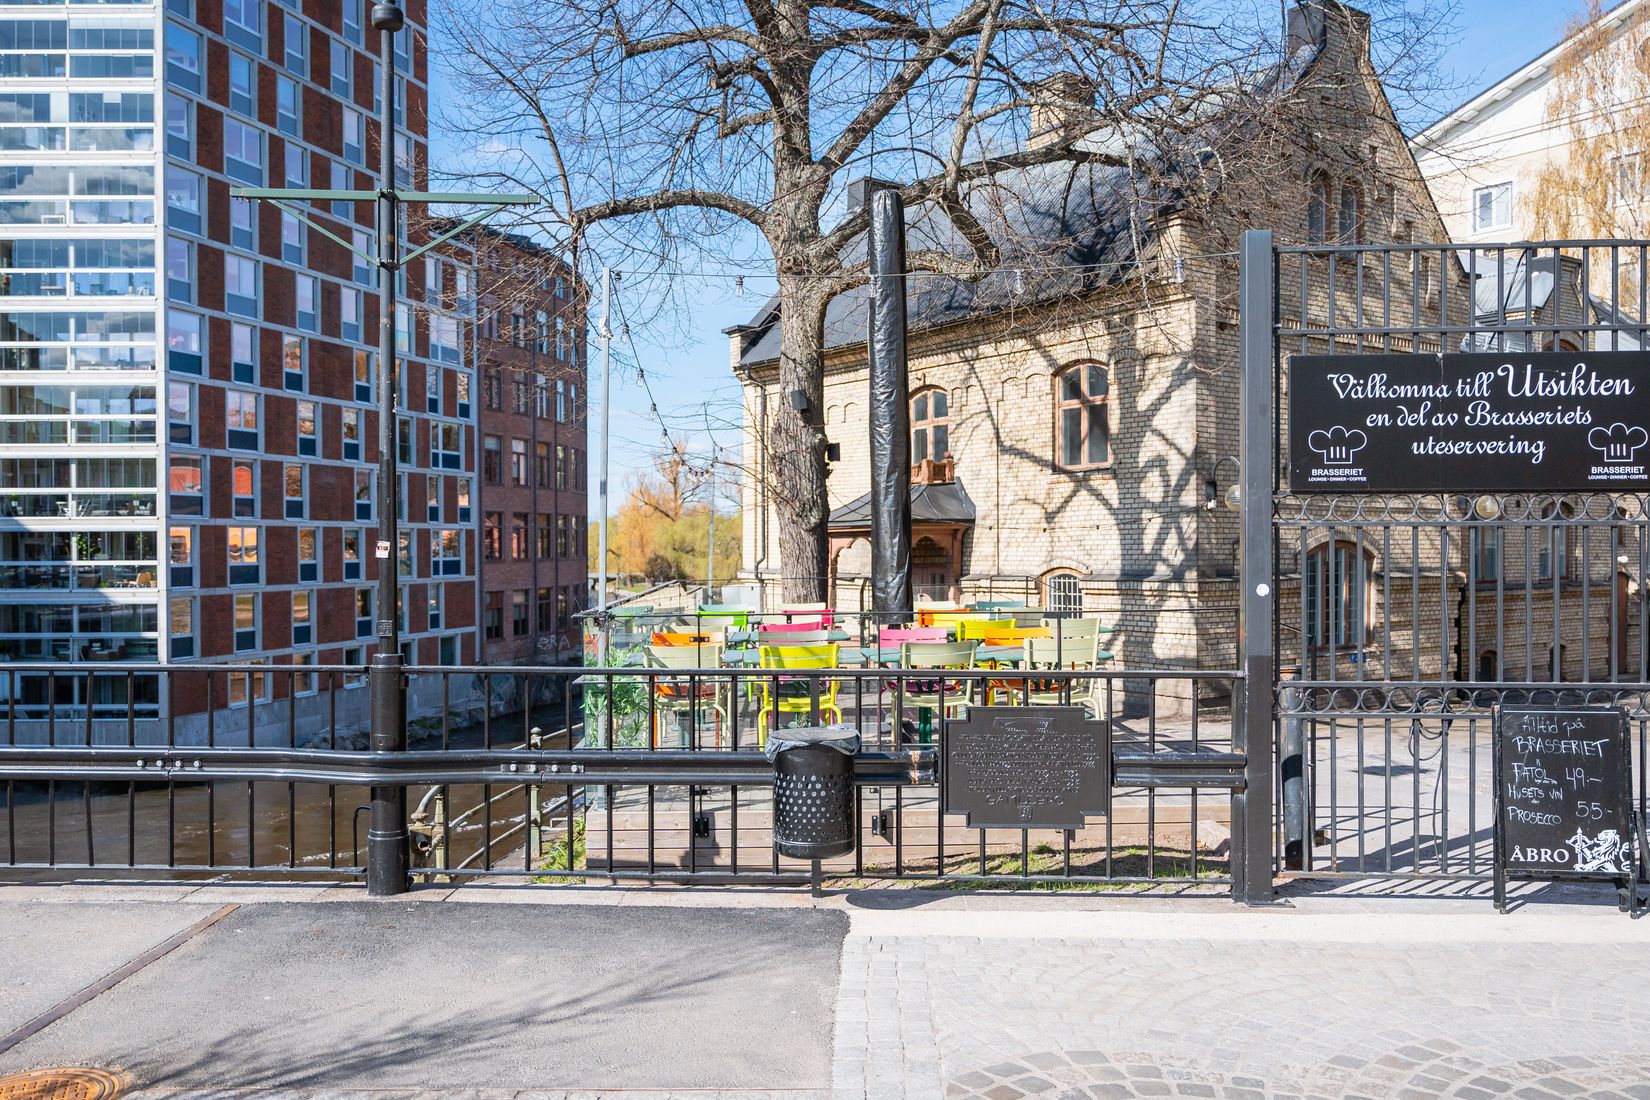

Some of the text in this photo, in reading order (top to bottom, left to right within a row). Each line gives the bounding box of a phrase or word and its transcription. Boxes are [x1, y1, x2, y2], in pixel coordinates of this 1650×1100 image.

[1327, 363, 1635, 399] Välkomna till Utsikten
[1366, 400, 1592, 427] en del av Brasseriets
[1411, 434, 1546, 464] uteservering
[1311, 468, 1364, 476] BRASSERIET
[1591, 466, 1645, 474] BRASSERIET
[1563, 717, 1586, 737] på
[1512, 735, 1610, 758] BRASSERIET
[1549, 787, 1563, 800] VIN
[1507, 805, 1562, 825] PROSECCO
[1509, 845, 1570, 863] ÅBRO
